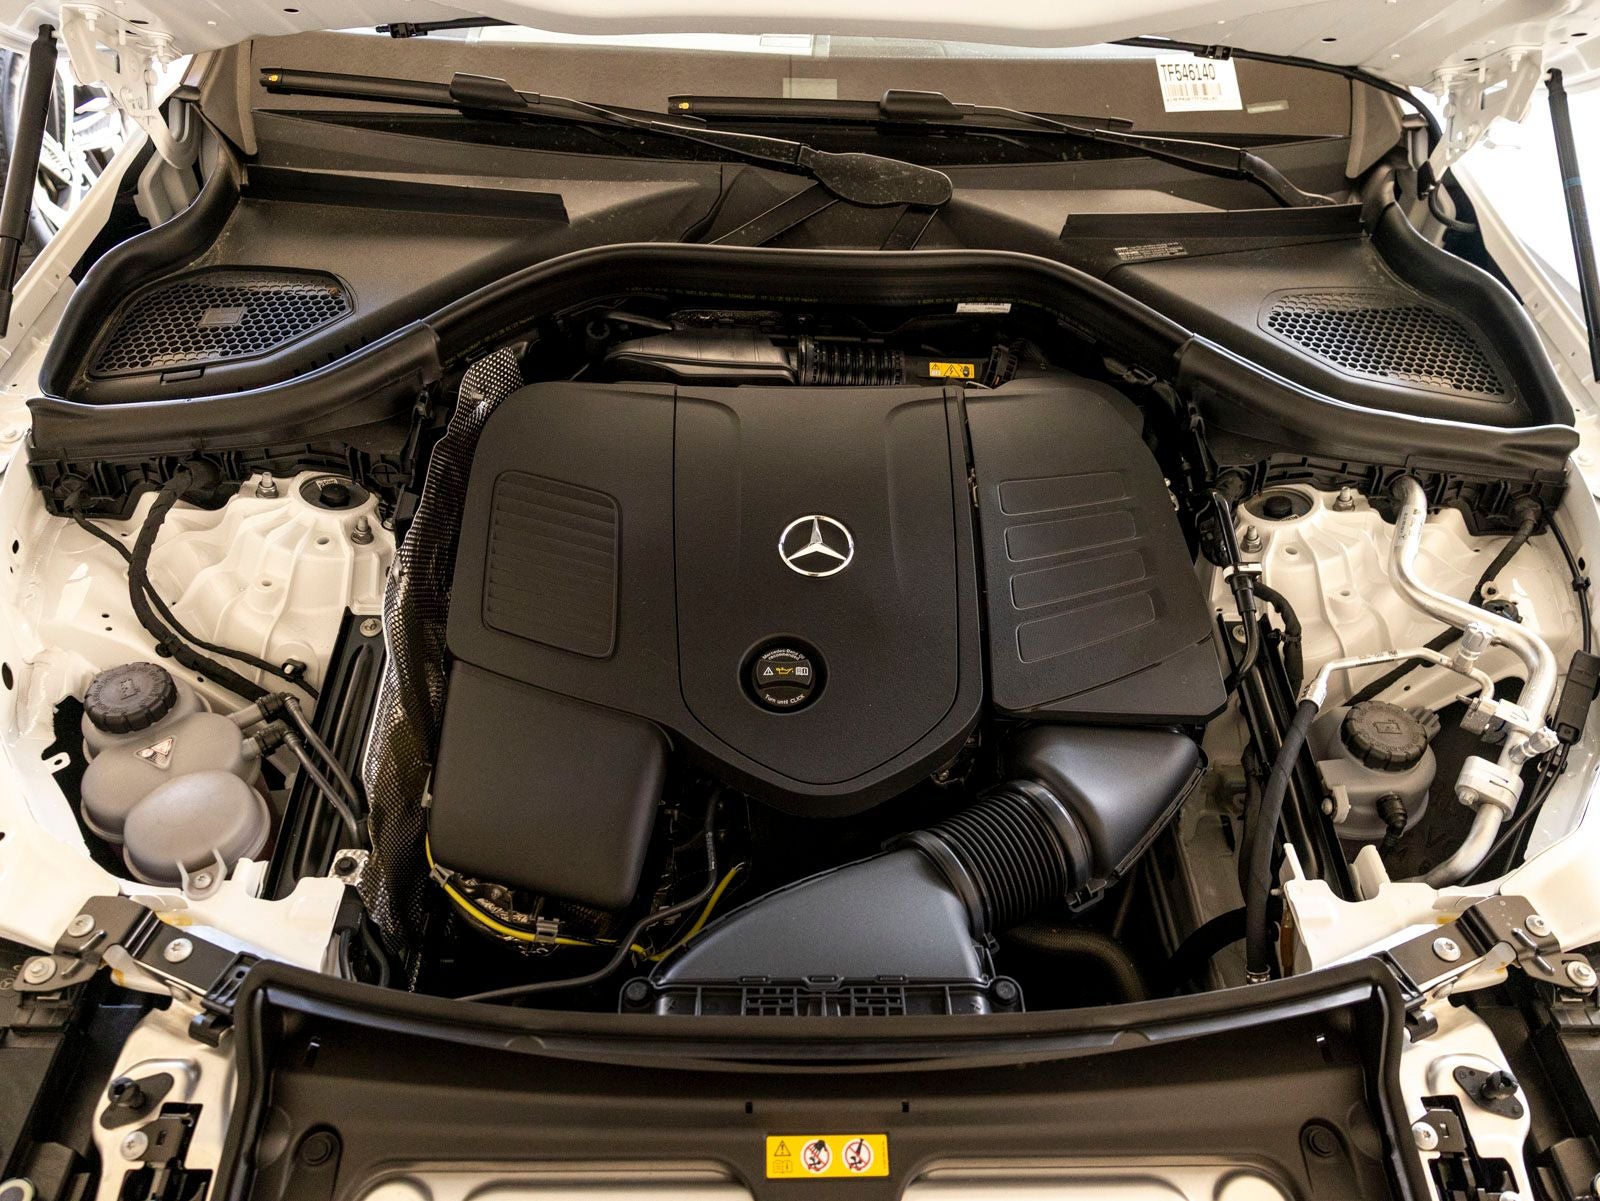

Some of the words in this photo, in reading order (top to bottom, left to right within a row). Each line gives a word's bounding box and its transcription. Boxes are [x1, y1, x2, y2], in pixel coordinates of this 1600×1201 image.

[1160, 63, 1216, 82] TF546140
[765, 693, 776, 704] Turn
[790, 693, 806, 704] CLICK
